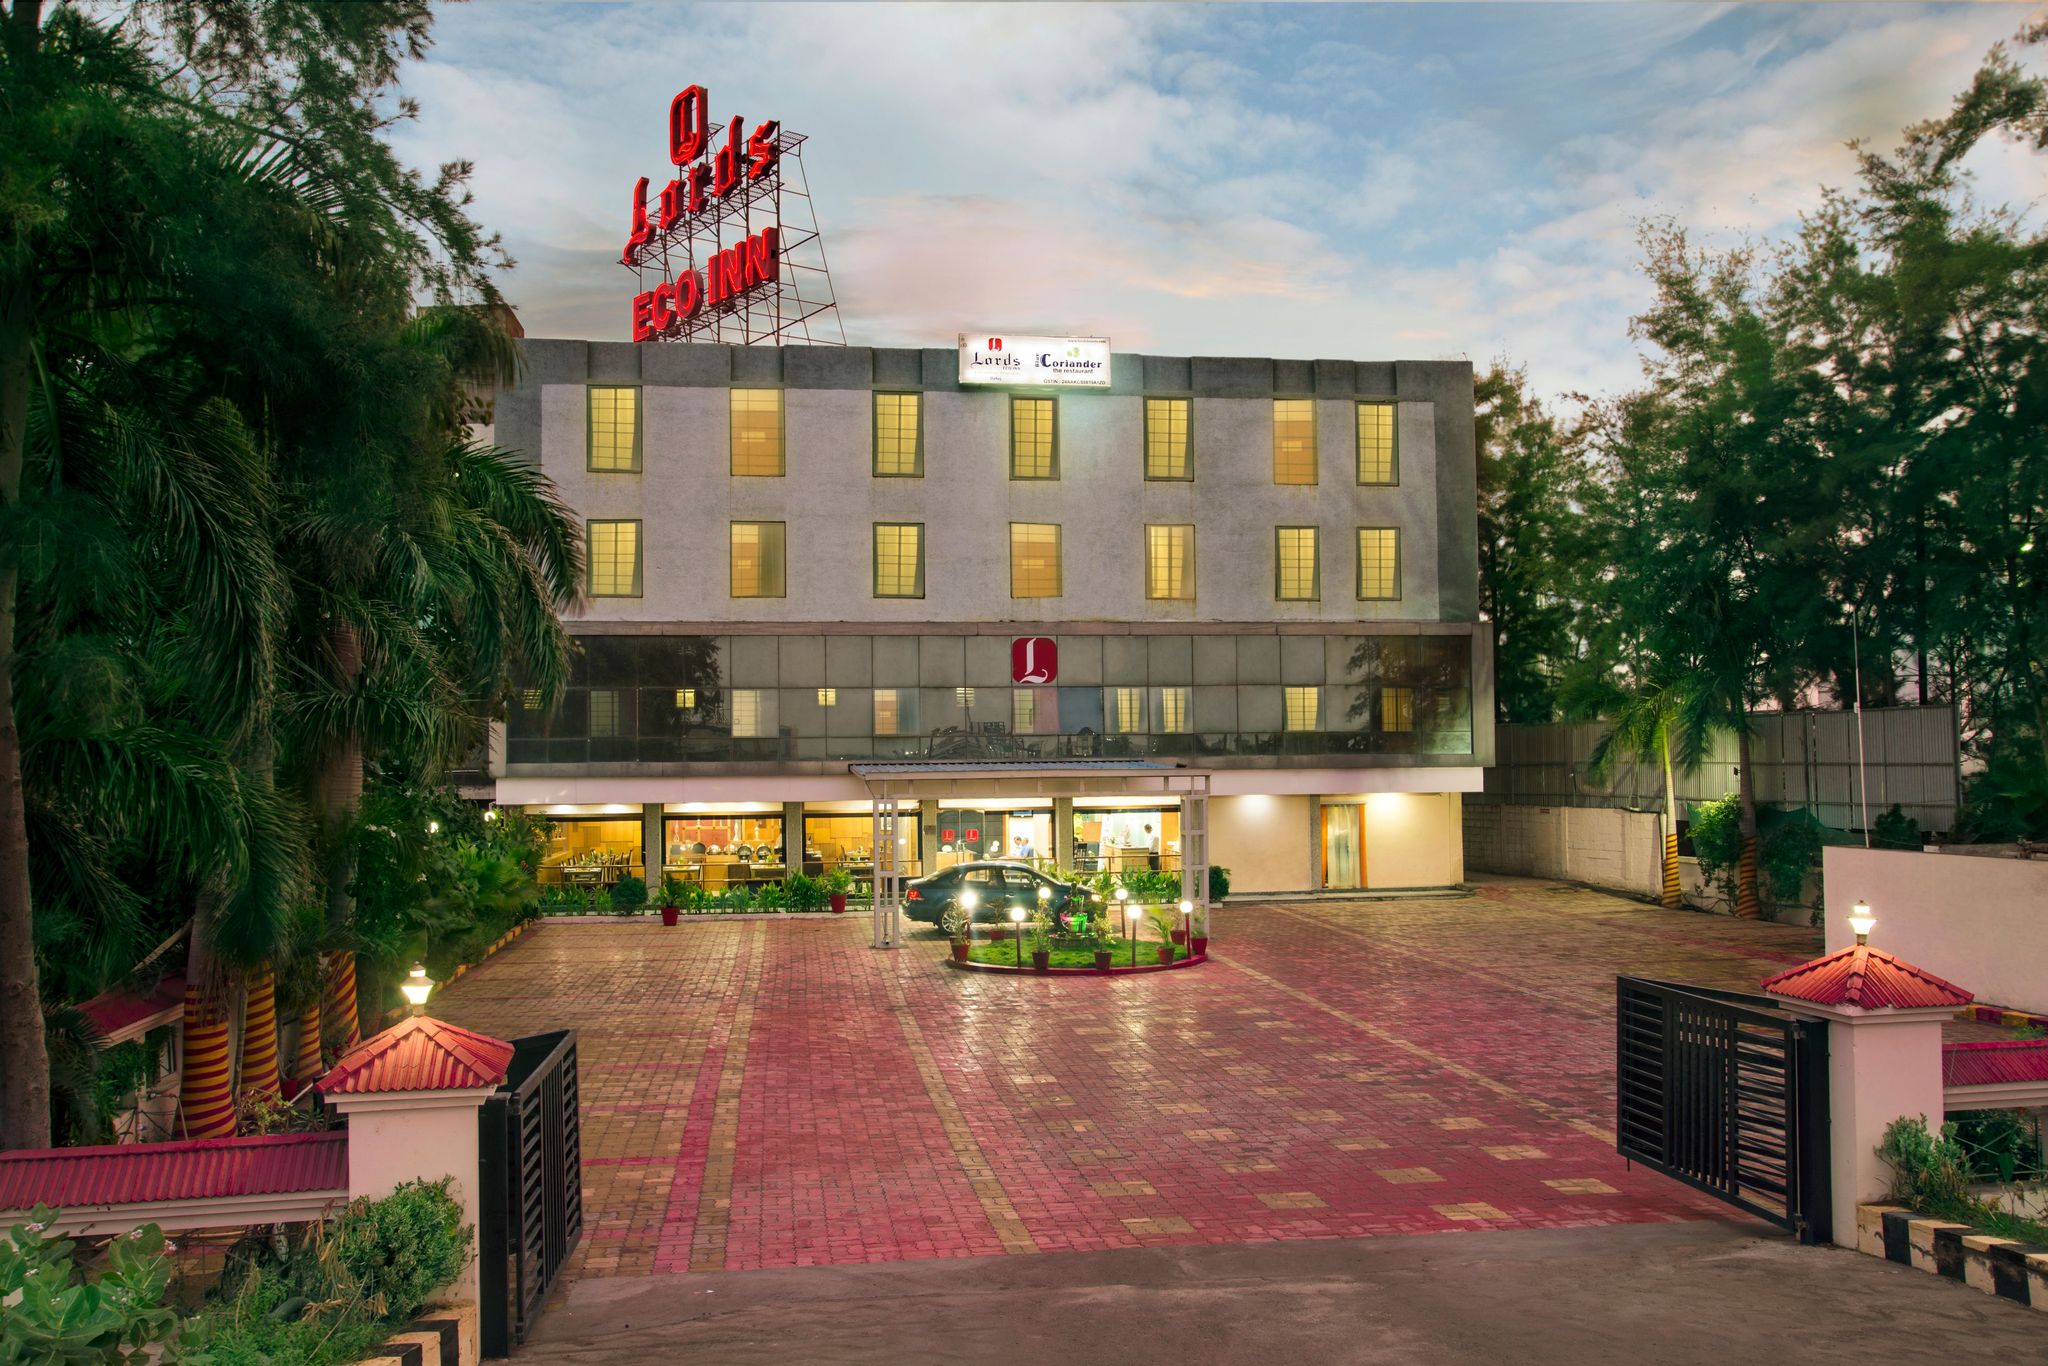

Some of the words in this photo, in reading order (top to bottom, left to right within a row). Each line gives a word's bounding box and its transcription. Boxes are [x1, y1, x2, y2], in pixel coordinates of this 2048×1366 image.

[623, 115, 779, 264] Lords
[632, 269, 704, 342] ECO
[708, 227, 779, 305] INN
[970, 351, 1021, 368] Lords
[1040, 353, 1102, 368] Coriander
[1019, 637, 1048, 684] L
